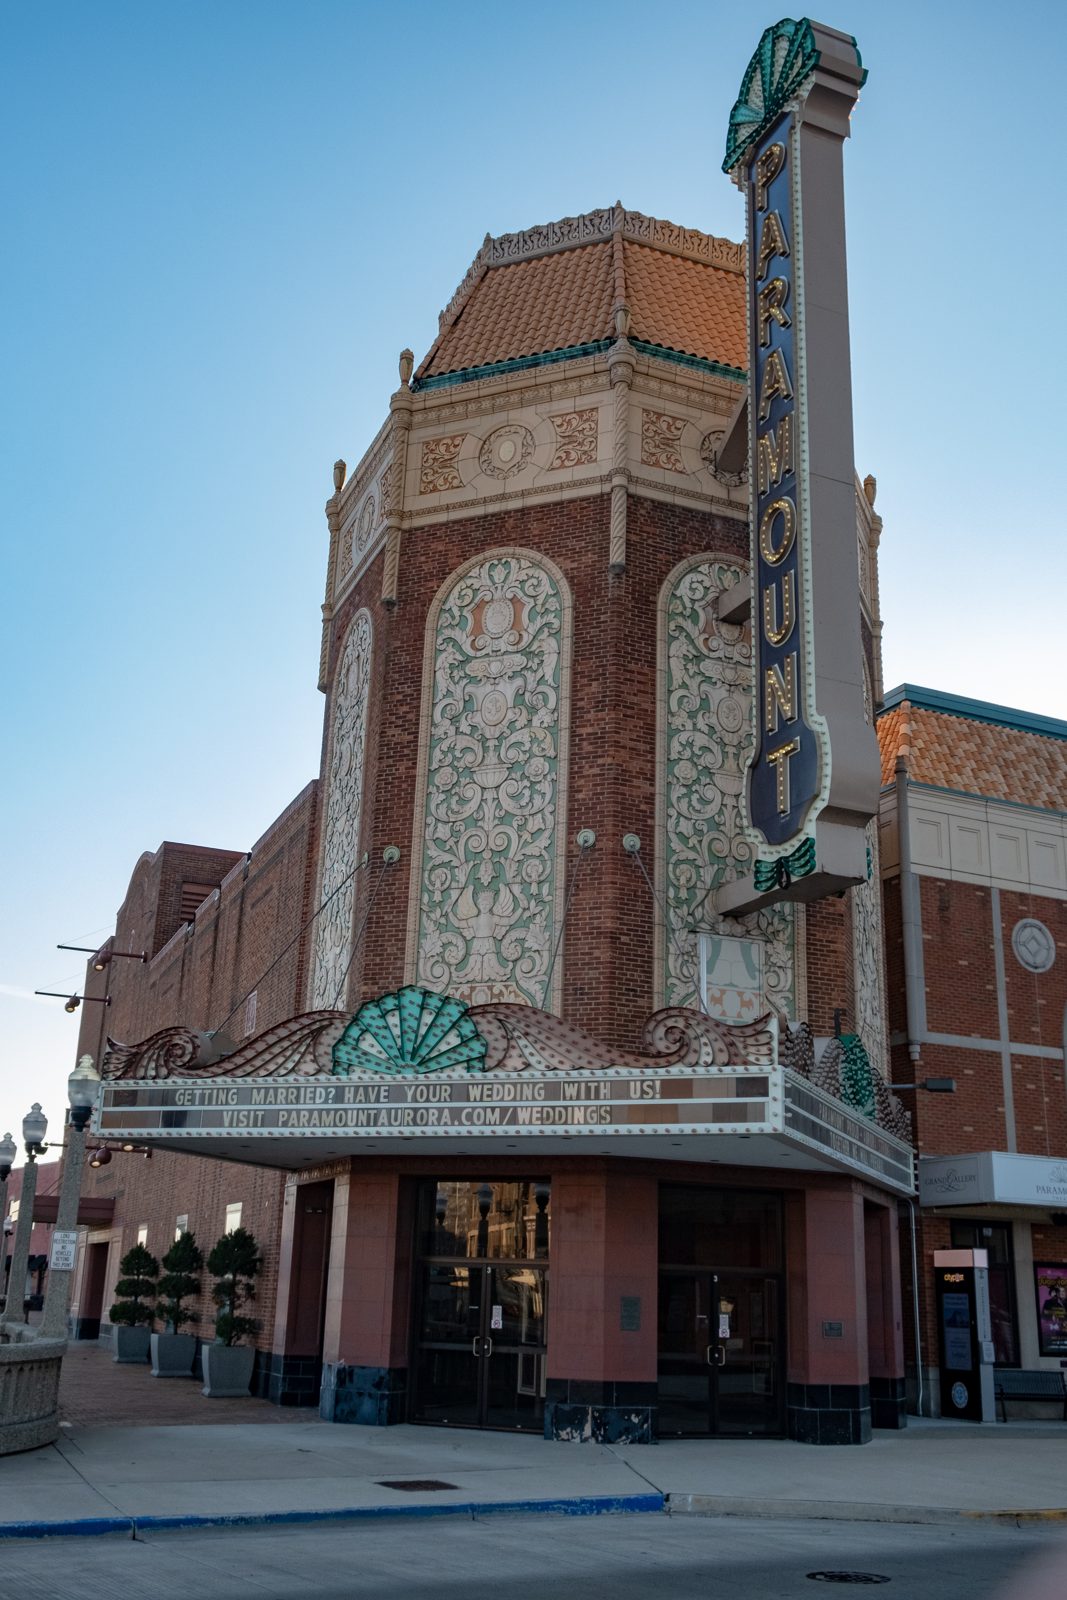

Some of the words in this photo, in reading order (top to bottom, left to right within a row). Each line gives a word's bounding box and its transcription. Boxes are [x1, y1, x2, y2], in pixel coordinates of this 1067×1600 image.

[755, 142, 800, 816] PARAMOUNT
[175, 1088, 238, 1105] GETTING
[251, 1087, 336, 1105] MARRIED?
[344, 1086, 389, 1104] HAVE
[404, 1084, 451, 1103] YOUR
[467, 1083, 545, 1102] WEDDING
[564, 1081, 611, 1100] WITH
[629, 1080, 662, 1099] US!
[222, 1110, 265, 1128] VISIT
[1035, 1184, 1067, 1195] PARAM
